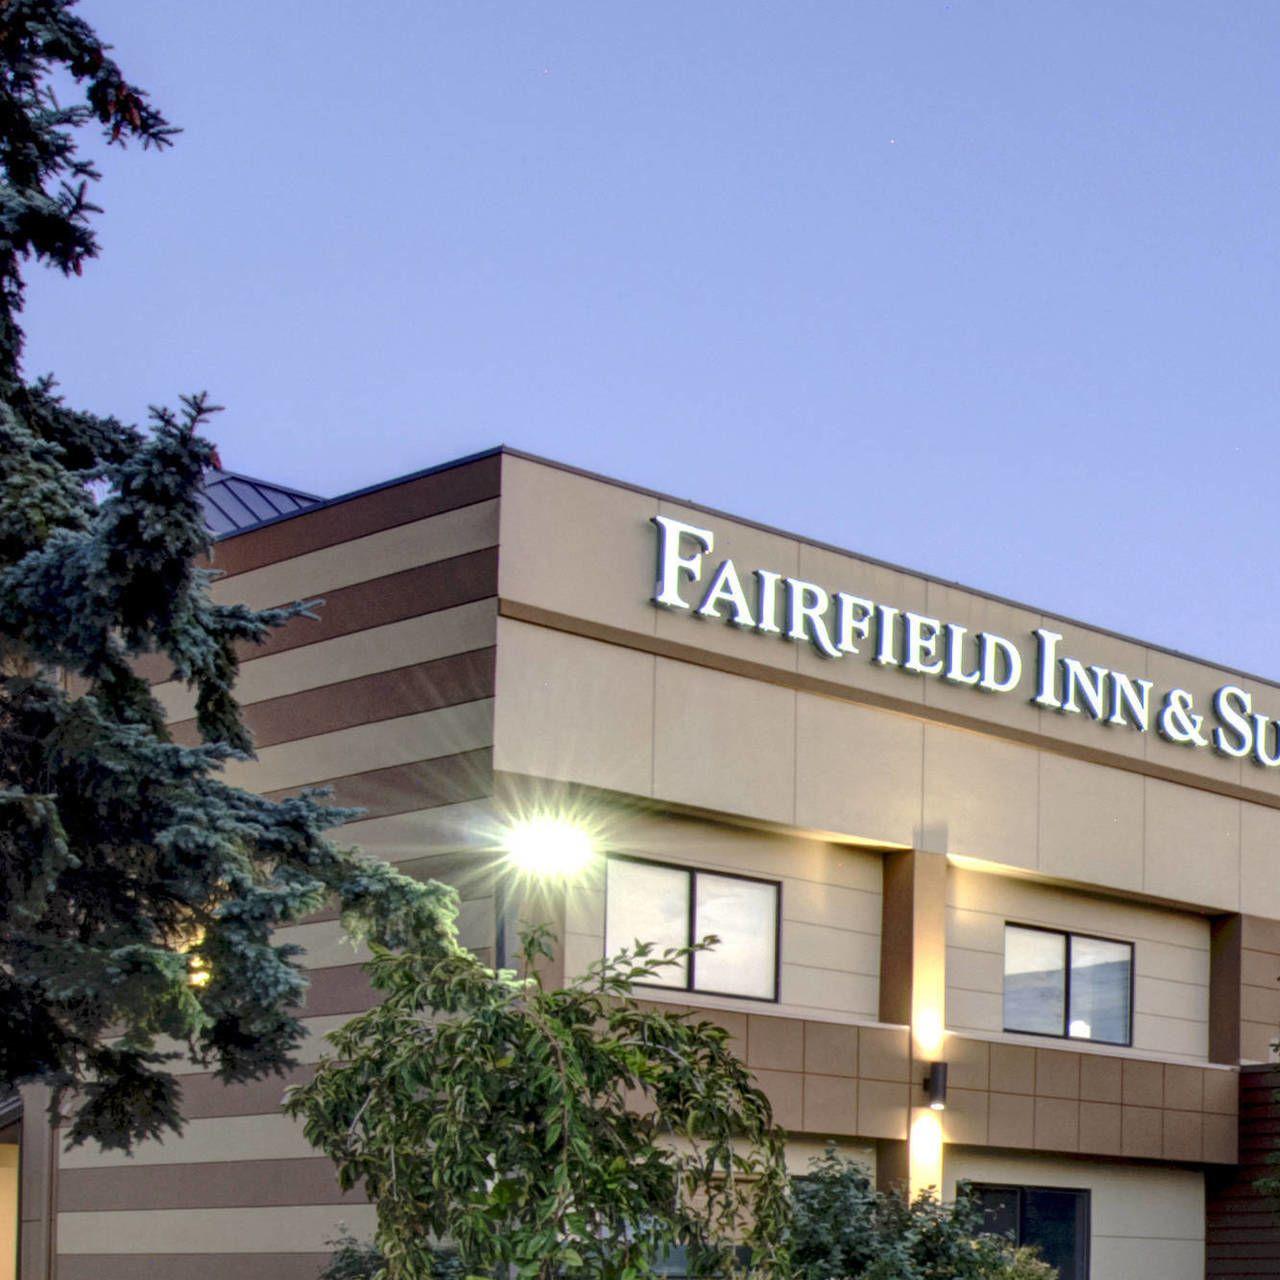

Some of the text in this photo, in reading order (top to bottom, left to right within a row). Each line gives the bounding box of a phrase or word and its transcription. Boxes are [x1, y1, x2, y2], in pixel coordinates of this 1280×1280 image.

[651, 515, 1022, 693] FAIRFIELD
[1033, 628, 1153, 732] INN
[1158, 688, 1208, 747] &
